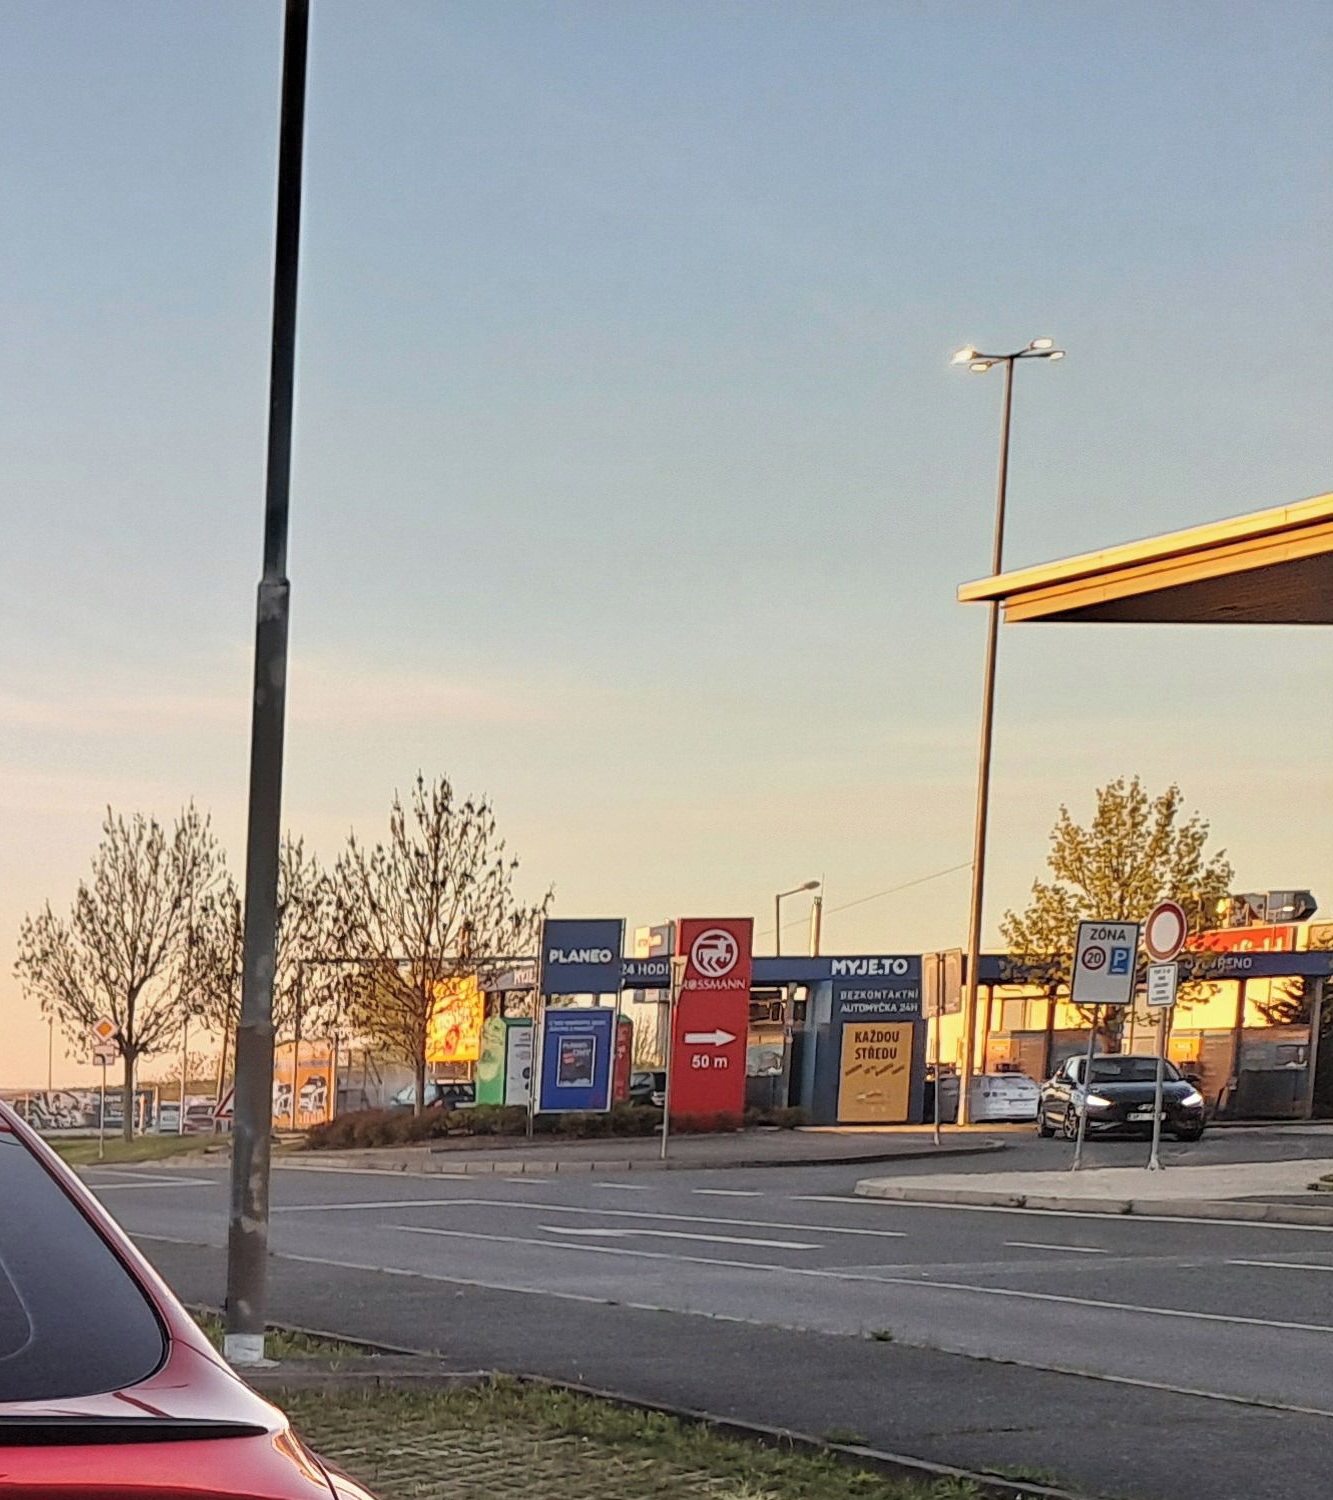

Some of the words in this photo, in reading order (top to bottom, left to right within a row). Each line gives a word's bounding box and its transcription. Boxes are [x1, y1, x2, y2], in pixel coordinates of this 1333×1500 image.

[548, 949, 612, 964] PLANEO
[1087, 952, 1102, 964] 20
[831, 958, 908, 976] MYJE.TO
[854, 1030, 900, 1044] KAŽDOU
[854, 1047, 898, 1060] STŘEDU
[692, 1055, 710, 1069] 50
[714, 1056, 728, 1069] m
